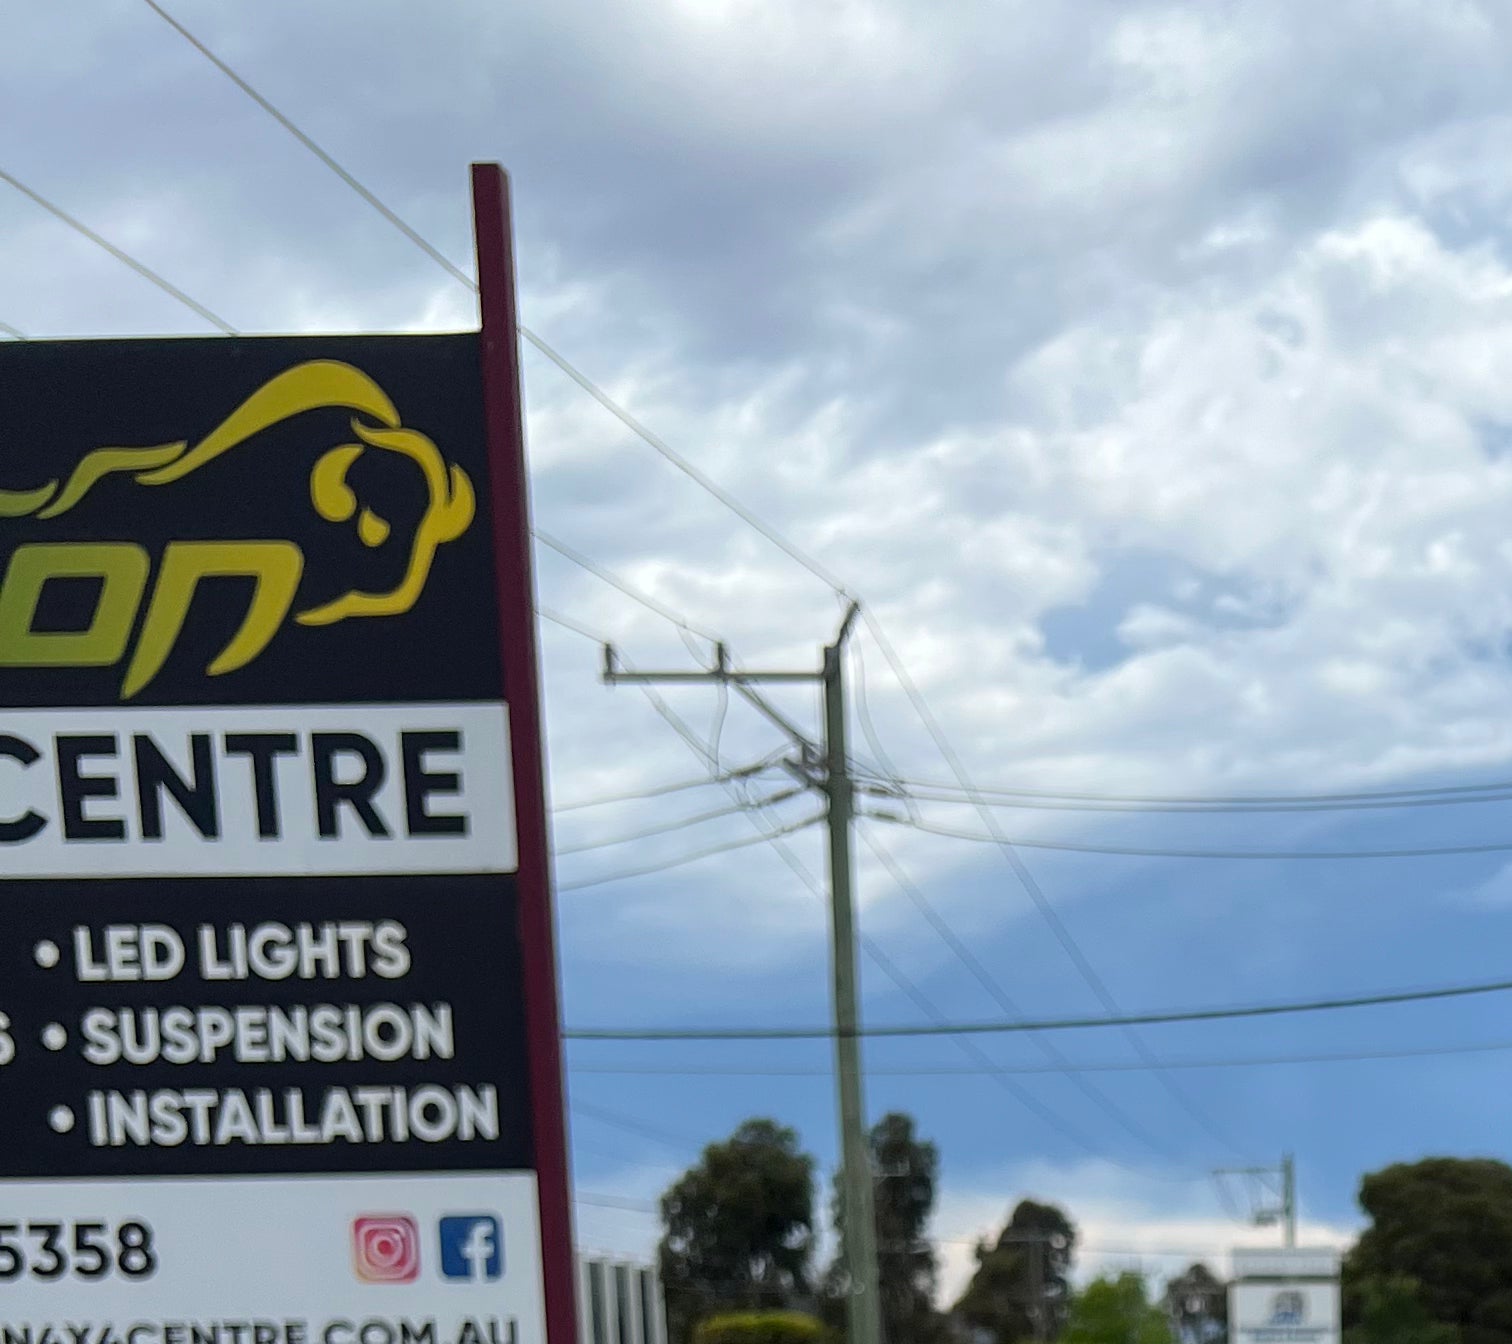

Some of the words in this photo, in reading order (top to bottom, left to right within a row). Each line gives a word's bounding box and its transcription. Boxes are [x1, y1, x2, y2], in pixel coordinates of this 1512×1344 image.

[0, 730, 468, 840] CENTRE
[72, 924, 186, 981] LED
[199, 919, 412, 980] LIGHTS
[80, 1002, 455, 1065] SUSPENSION
[86, 1083, 500, 1146] INSTALLATION
[0, 1220, 157, 1280] 5358
